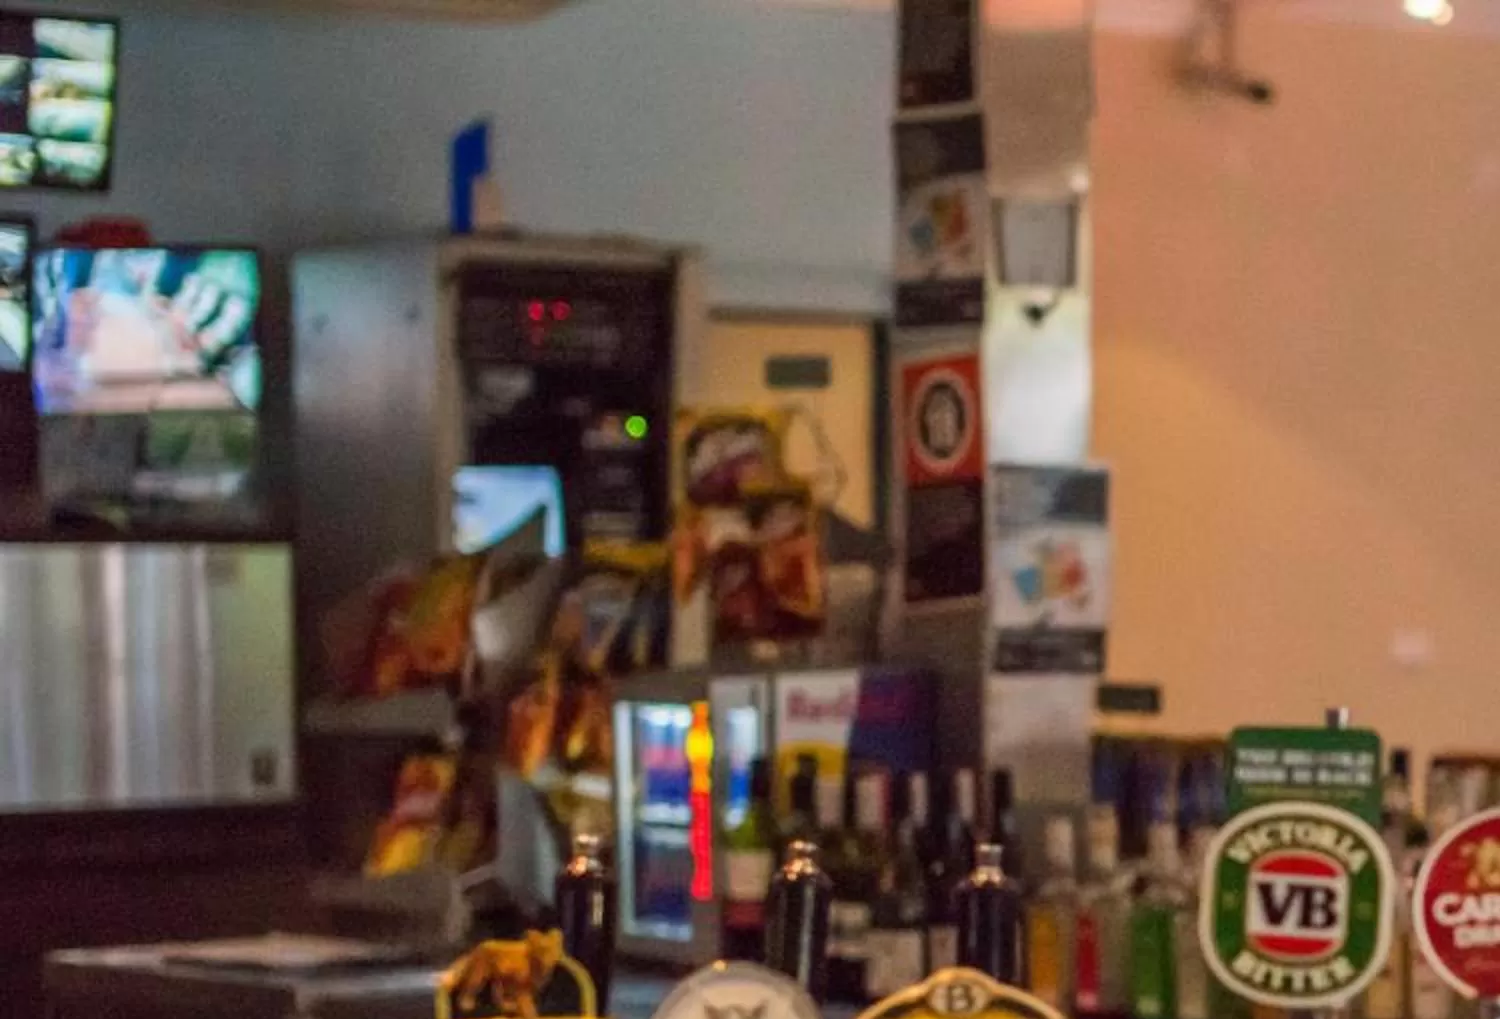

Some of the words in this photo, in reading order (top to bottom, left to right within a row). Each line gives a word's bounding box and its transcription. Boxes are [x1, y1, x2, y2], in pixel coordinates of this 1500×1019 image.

[1227, 820, 1368, 873] VICTORIA
[1256, 882, 1338, 929] VB
[1231, 950, 1355, 991] BITTER
[946, 983, 976, 1008] B
